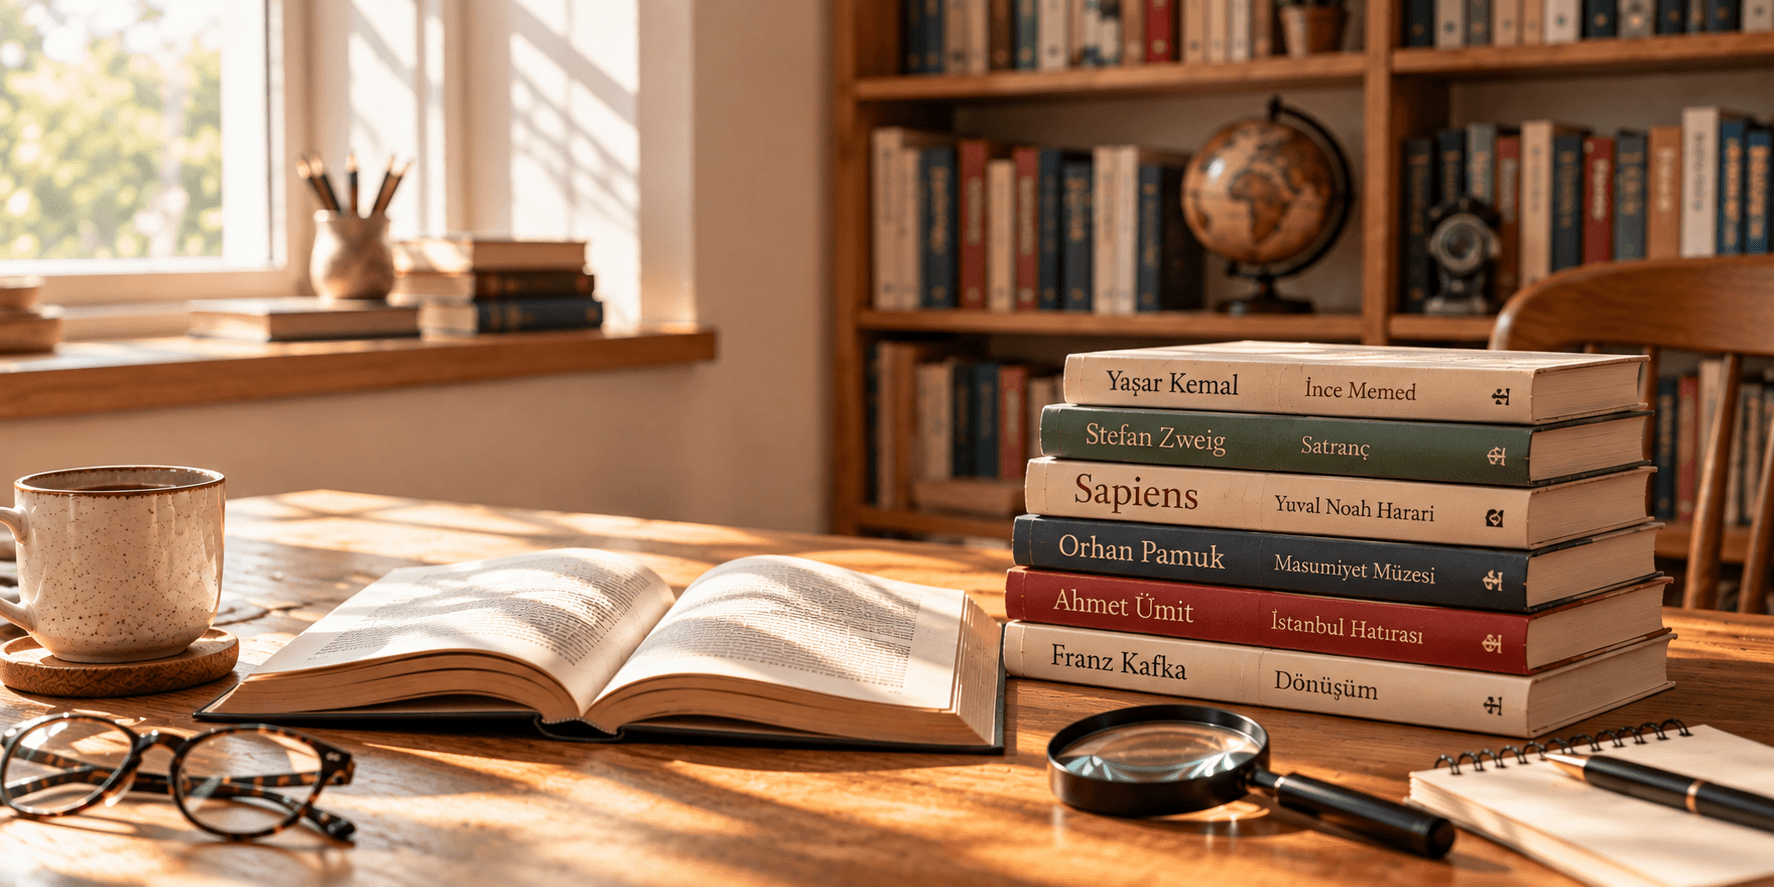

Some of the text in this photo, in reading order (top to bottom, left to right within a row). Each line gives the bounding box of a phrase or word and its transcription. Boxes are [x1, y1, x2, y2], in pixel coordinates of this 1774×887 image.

[1106, 370, 1239, 397] Yaşar Kemal
[1304, 376, 1417, 401] İnce Memed
[1086, 422, 1226, 458] Stefan Zweig
[1300, 435, 1370, 461] Satranç
[1075, 474, 1197, 513] Sapiens
[1274, 494, 1435, 522] Yuval Noah Harari
[1059, 534, 1226, 570] Orhan Pamuk
[1273, 553, 1436, 585] Masumiyet Müzesi
[1052, 588, 1194, 623] Ahmet Ümit
[1271, 610, 1424, 645] İstanbul Hatırası
[1051, 643, 1188, 681] Franz Kafka
[1274, 669, 1378, 701] Dönüşüm
